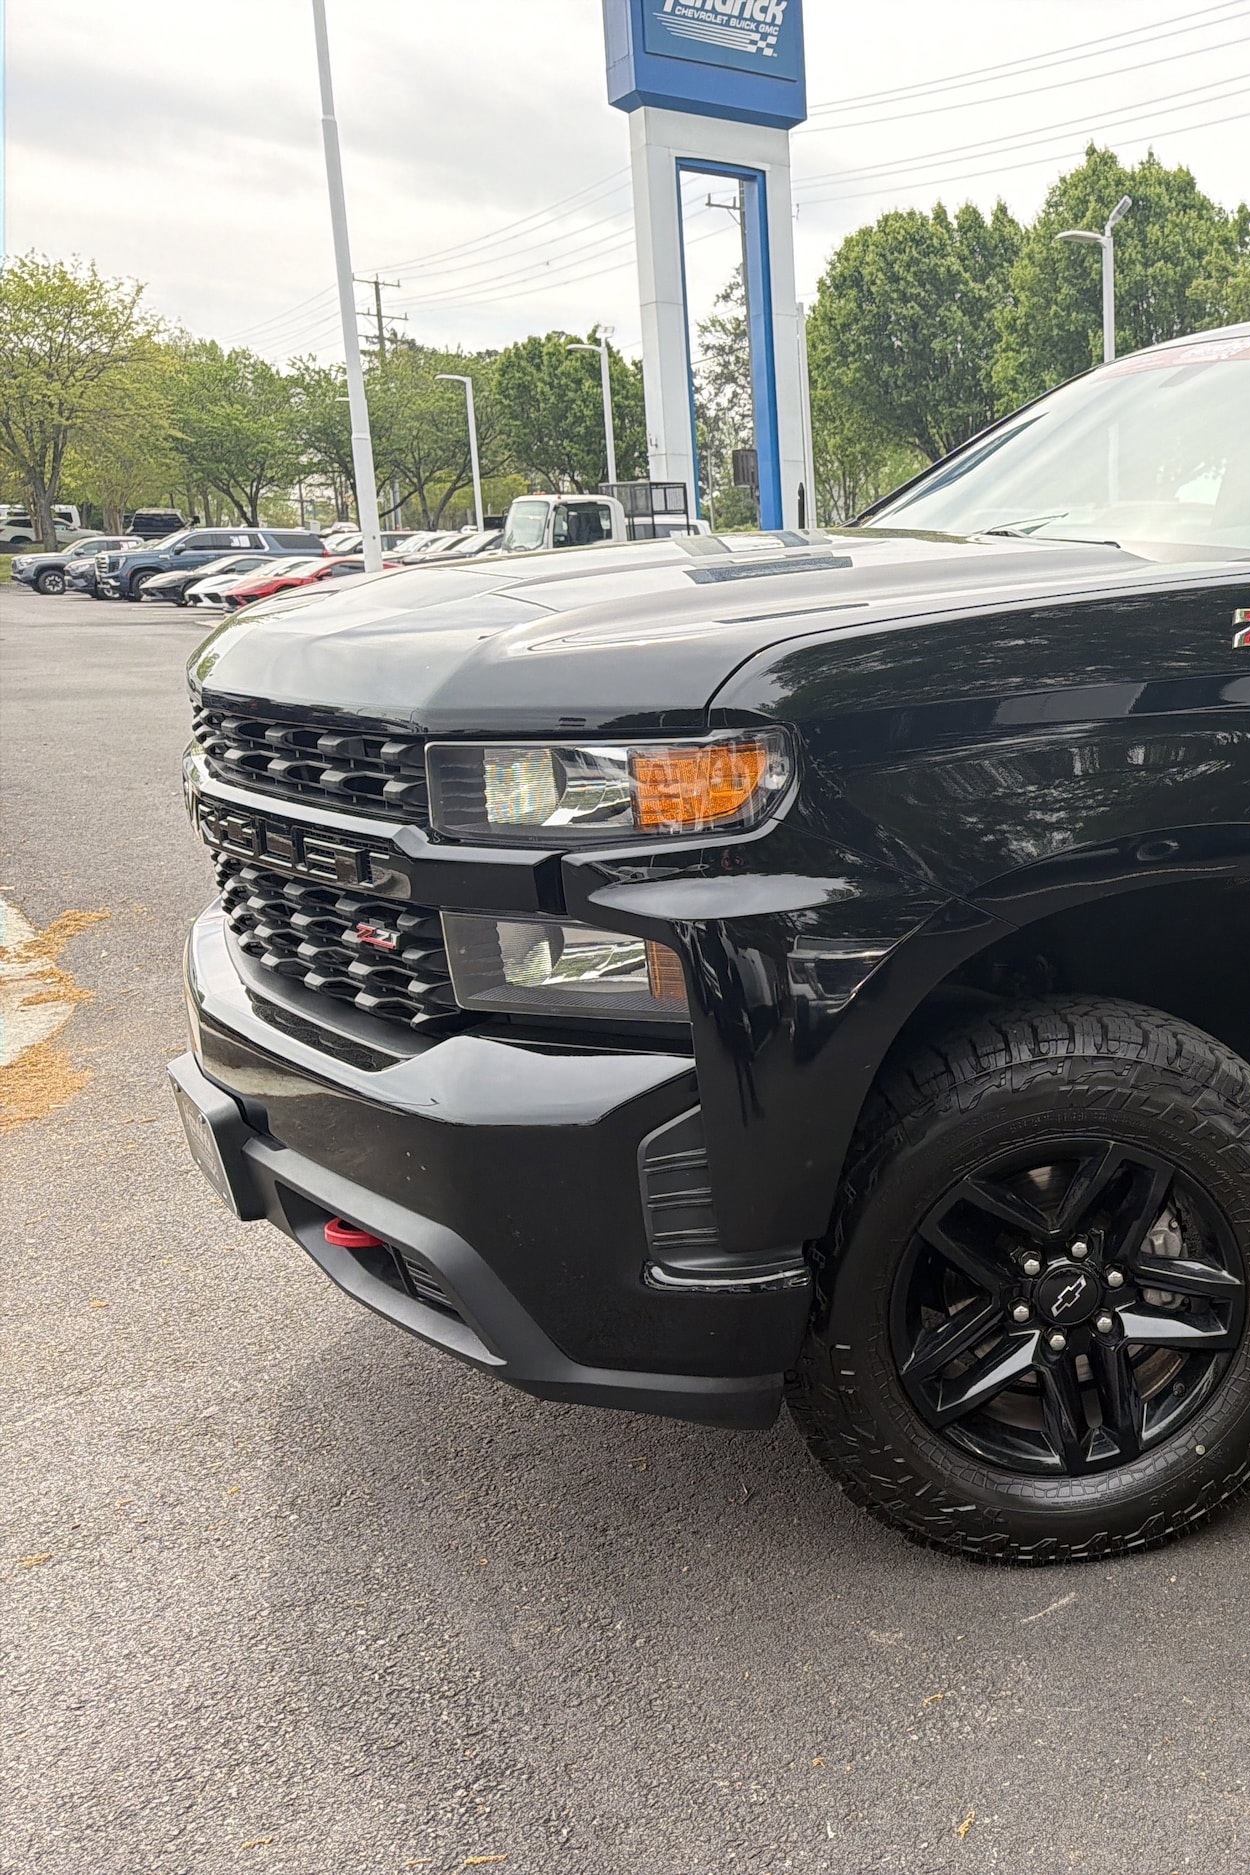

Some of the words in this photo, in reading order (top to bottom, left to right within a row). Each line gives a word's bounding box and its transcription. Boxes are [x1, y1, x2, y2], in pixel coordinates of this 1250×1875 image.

[674, 6, 728, 25] CHEVROLET
[729, 17, 757, 31] BUICK
[758, 23, 780, 35] GMC
[355, 921, 401, 950] Z71
